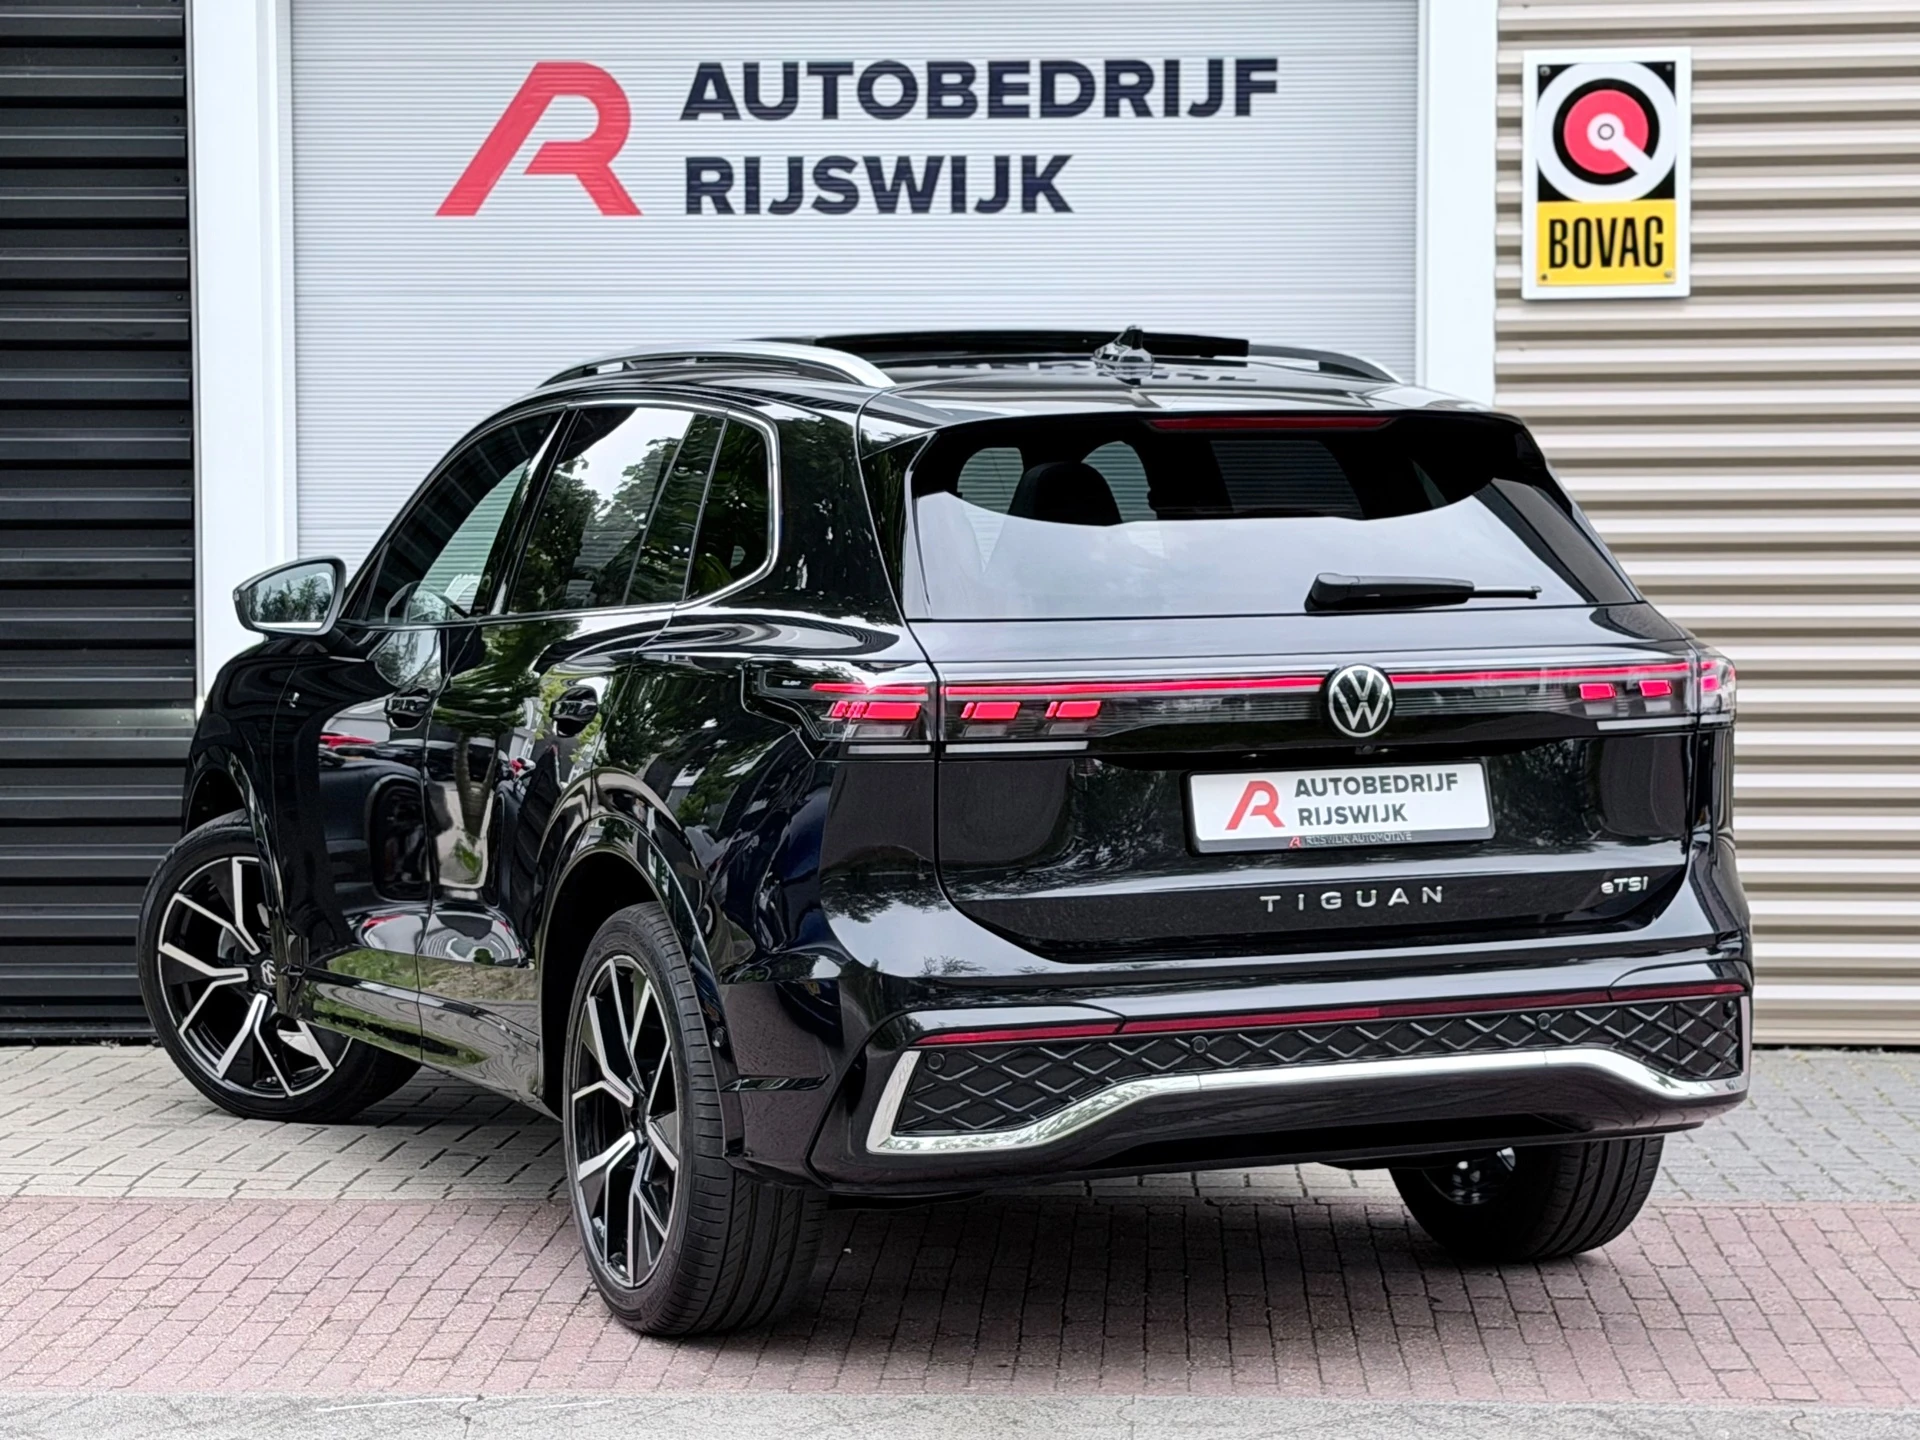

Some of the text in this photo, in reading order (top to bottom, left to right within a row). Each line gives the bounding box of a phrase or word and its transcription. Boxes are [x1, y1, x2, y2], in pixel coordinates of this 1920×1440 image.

[680, 57, 1279, 121] AUTOBEDRIJF
[684, 154, 1074, 216] RIJSWIJK
[1548, 215, 1664, 269] BOVAG
[1294, 772, 1458, 798] AUTOBEDRIJF
[1298, 803, 1408, 827] RIJSWIJK
[1259, 885, 1443, 913] TIGUAN
